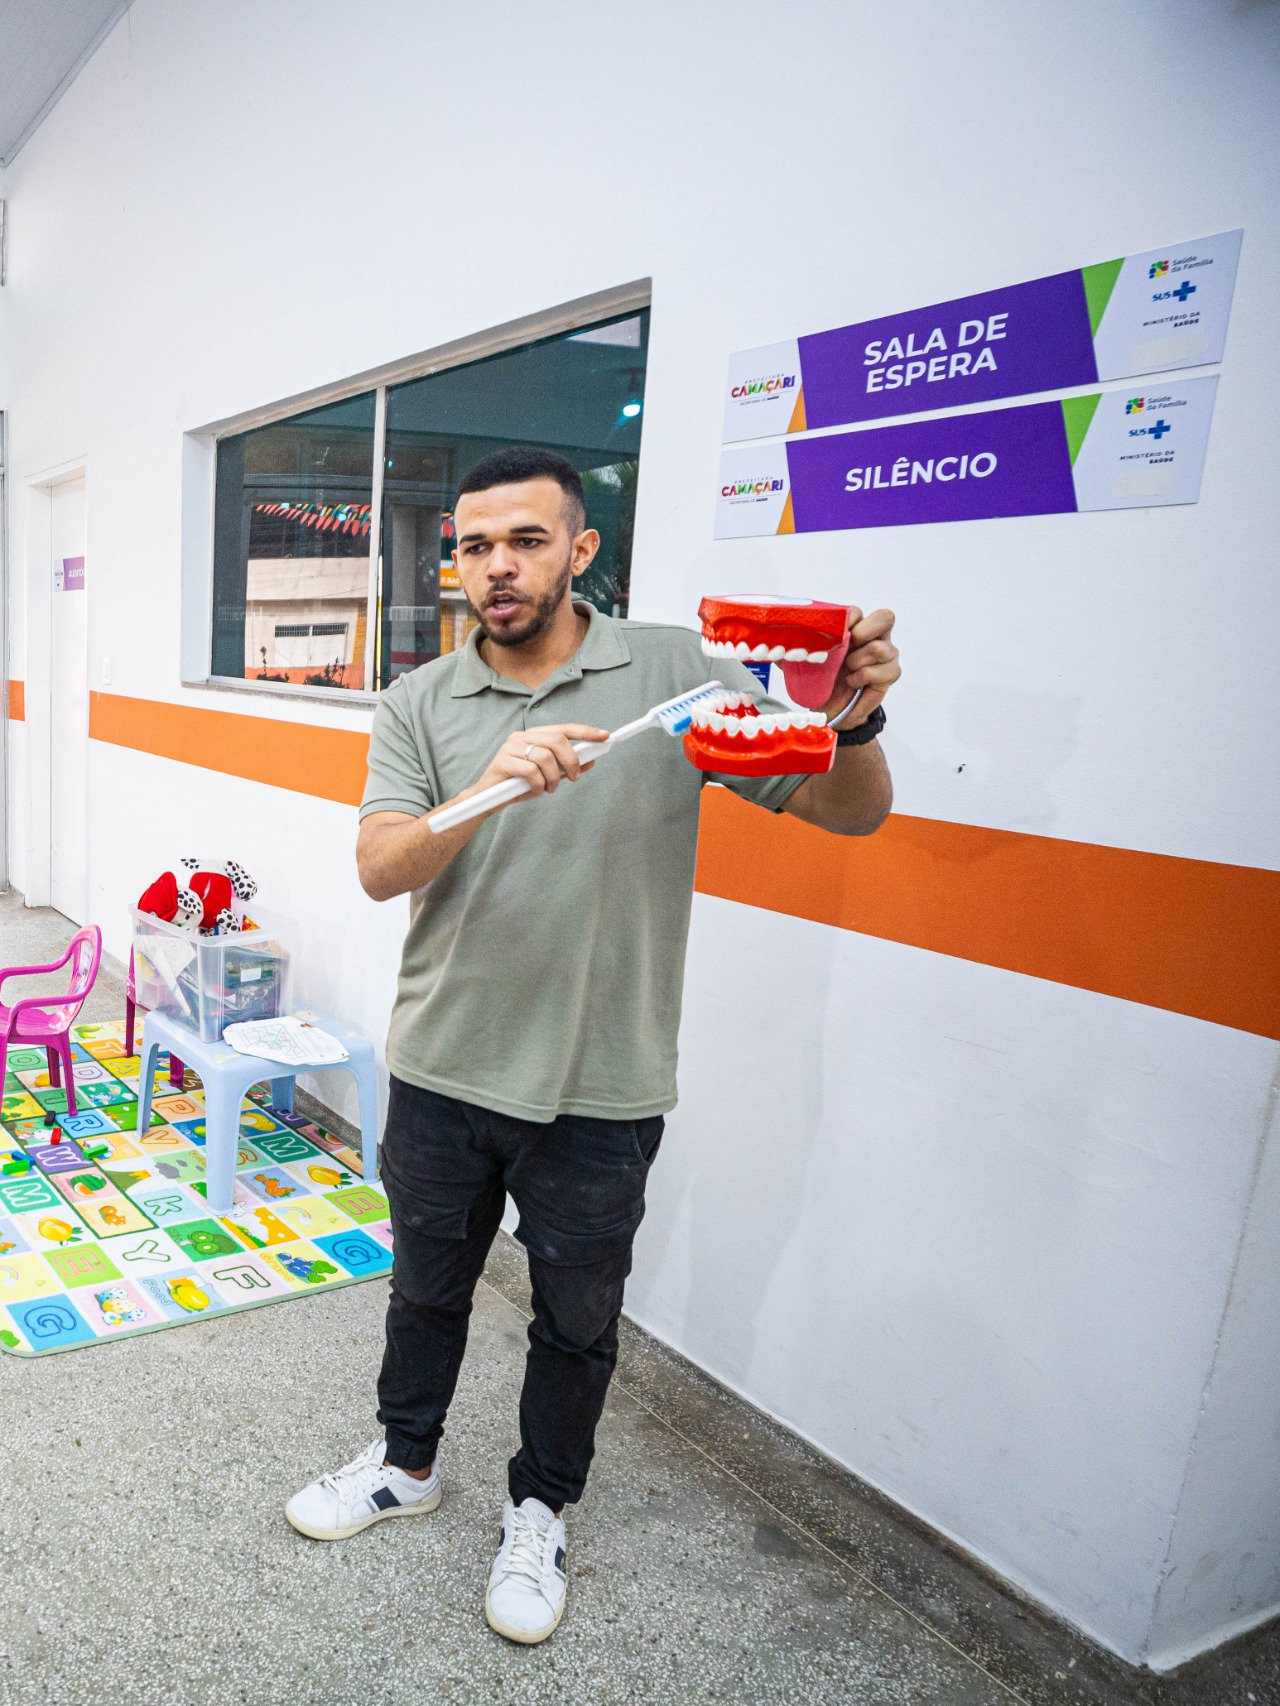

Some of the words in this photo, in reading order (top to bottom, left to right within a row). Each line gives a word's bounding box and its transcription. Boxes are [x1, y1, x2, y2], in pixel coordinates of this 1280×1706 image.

[1152, 291, 1172, 302] SUS
[863, 327, 948, 366] SALA
[957, 312, 1009, 347] DE
[866, 347, 998, 394] ESPERA
[731, 375, 796, 398] CAMAÇARI
[1128, 428, 1147, 438] SUS
[844, 452, 998, 492] SILÊNCIO
[721, 479, 784, 497] CAMAÇARI
[154, 1100, 195, 1115] P
[63, 1114, 104, 1132] R
[334, 1190, 387, 1216] E
[52, 1248, 107, 1279] E
[122, 1239, 171, 1262] Y
[331, 1238, 383, 1266] G
[213, 1264, 272, 1290] F
[142, 1279, 174, 1306] Food
[23, 1304, 78, 1339] G
